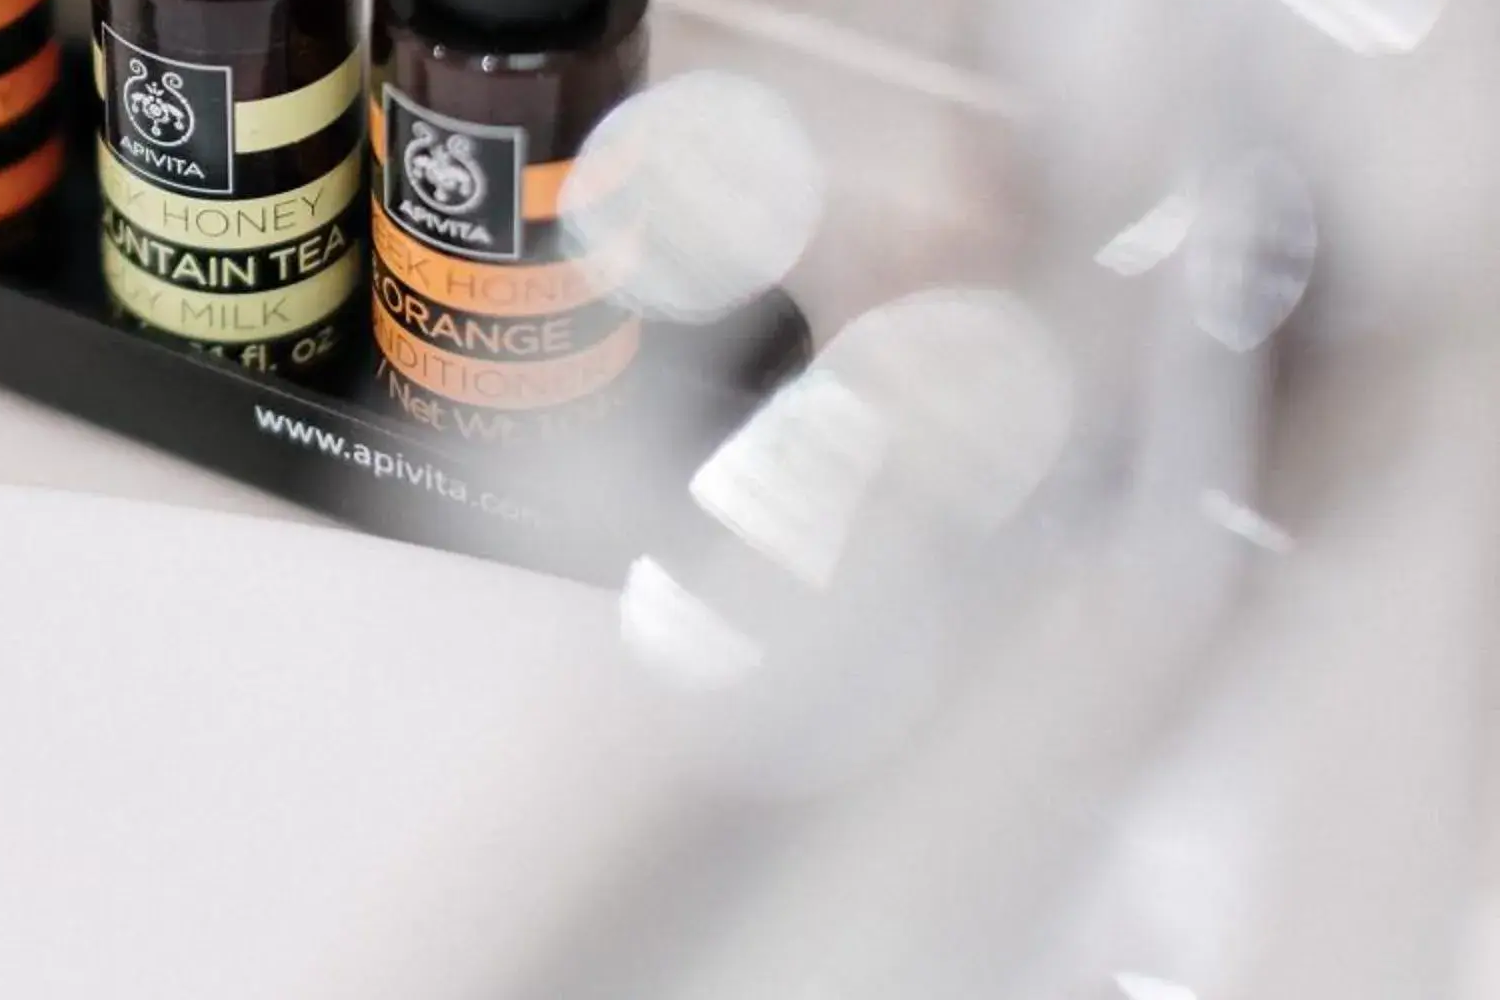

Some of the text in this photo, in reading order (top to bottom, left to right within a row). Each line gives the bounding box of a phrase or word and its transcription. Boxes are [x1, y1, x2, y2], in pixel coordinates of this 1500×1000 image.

[119, 135, 205, 178] APIVITA
[162, 186, 324, 237] HONEY
[399, 199, 493, 244] APIVITA
[268, 226, 346, 279] TEA
[180, 297, 292, 332] MILK
[382, 276, 573, 355] ORANGE
[389, 370, 448, 431] Net
